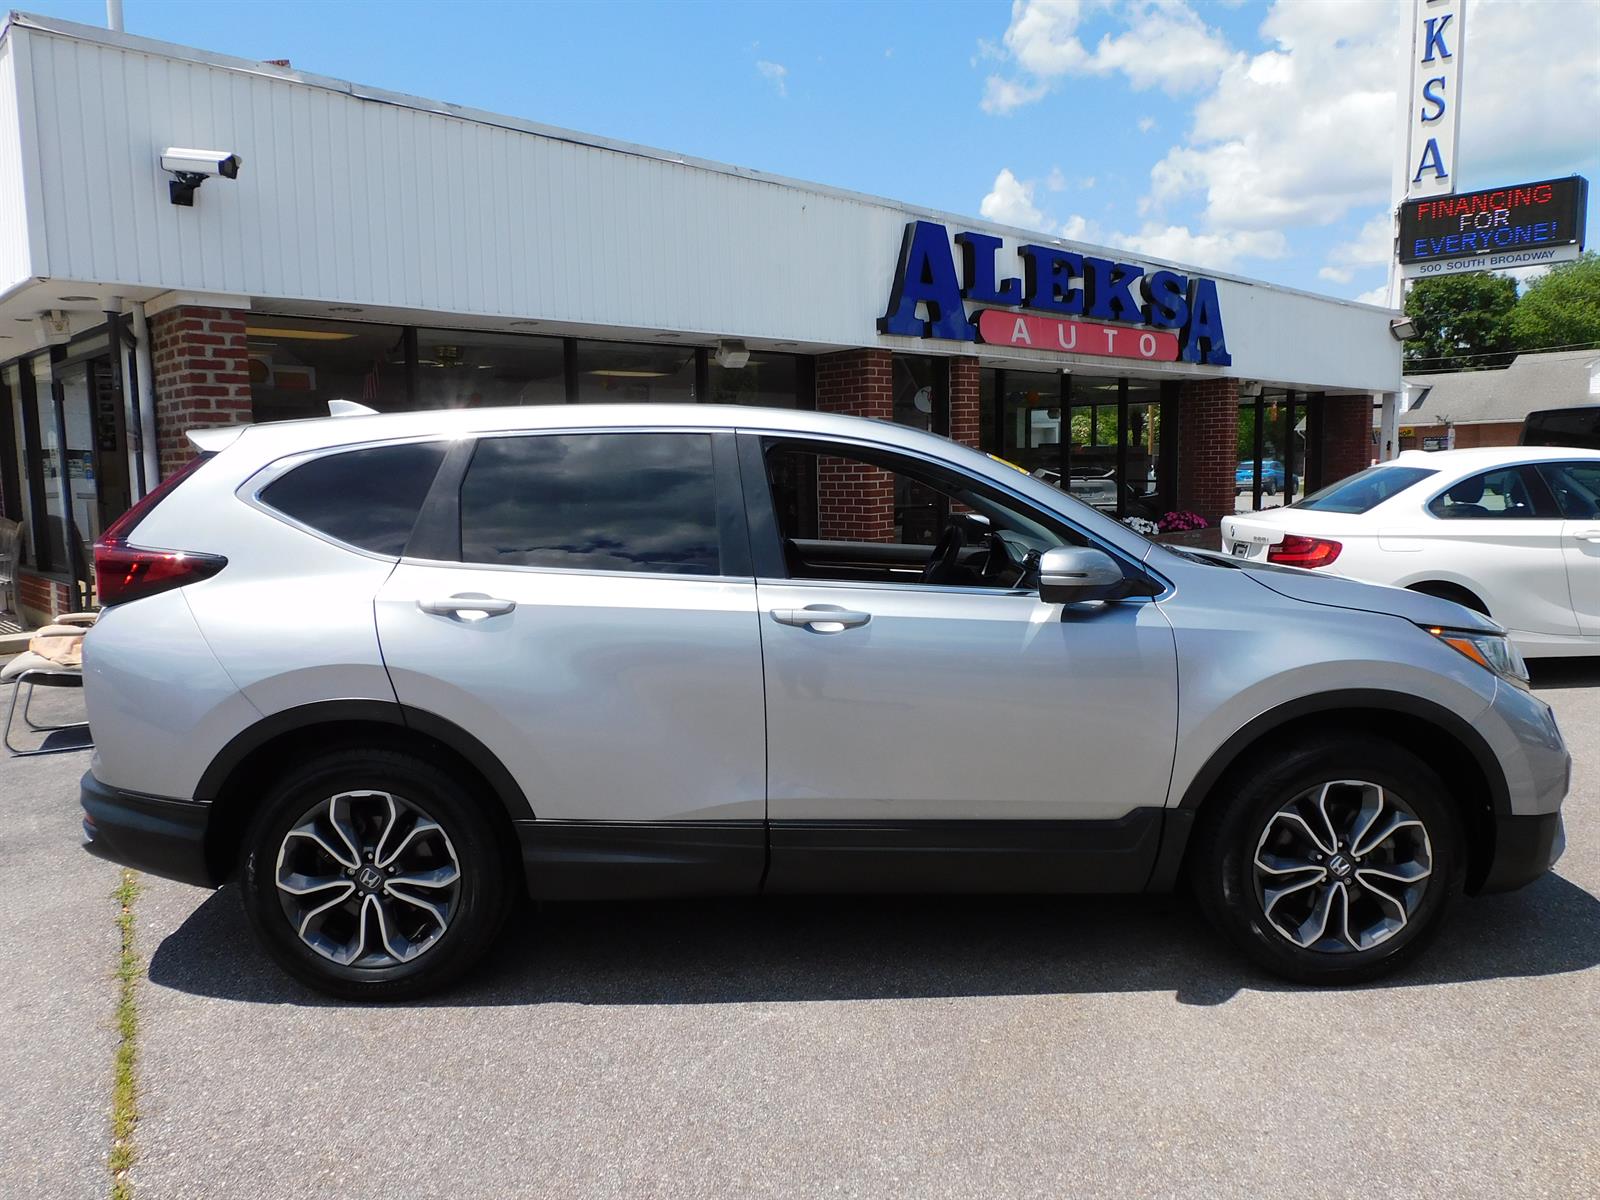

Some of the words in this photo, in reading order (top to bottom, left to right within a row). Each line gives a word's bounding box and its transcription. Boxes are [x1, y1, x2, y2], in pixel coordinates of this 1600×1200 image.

[1412, 0, 1454, 182] KSA
[1417, 184, 1553, 222] FINANCING
[1459, 208, 1511, 232] FOR
[1413, 221, 1558, 258] EVERYONE!
[1419, 263, 1442, 274] 500
[1446, 257, 1486, 271] SOUTH
[1490, 250, 1556, 266] BROADWAY
[876, 220, 1232, 367] ALEKSA
[1010, 317, 1157, 358] AUTO
